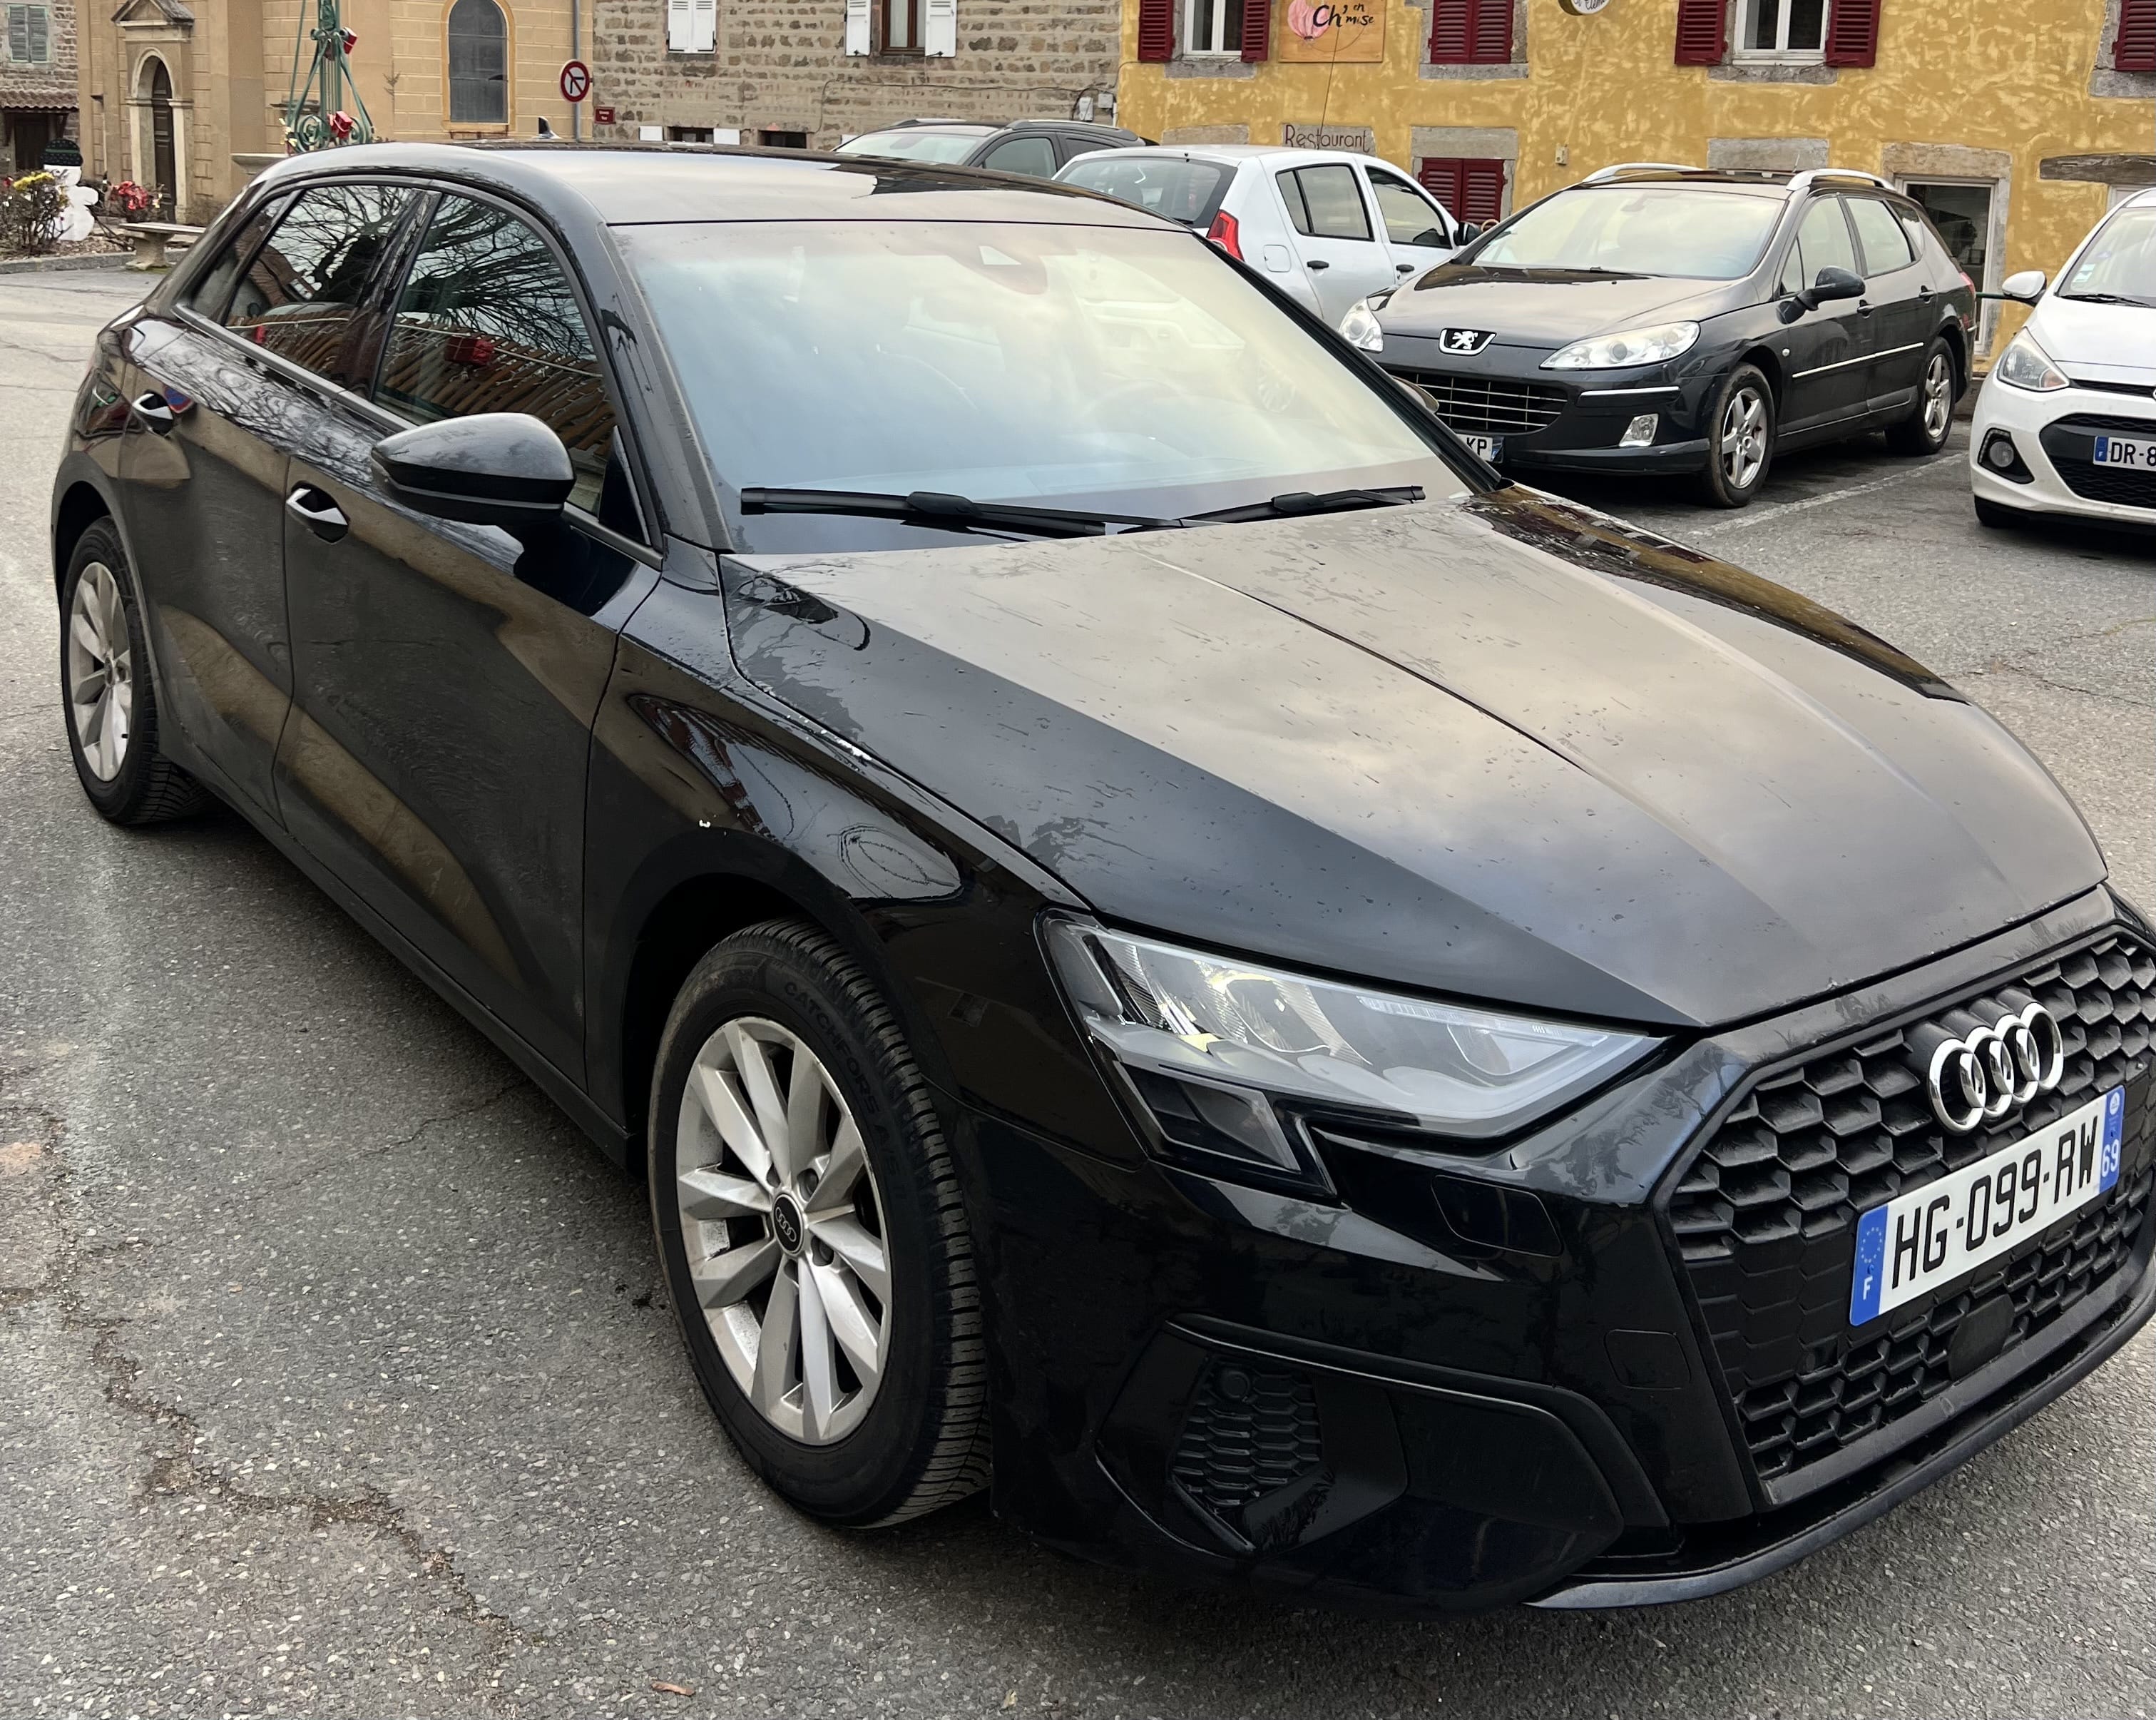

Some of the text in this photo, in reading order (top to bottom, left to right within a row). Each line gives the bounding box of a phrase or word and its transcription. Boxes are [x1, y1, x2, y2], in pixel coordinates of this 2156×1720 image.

[1284, 124, 1370, 153] Restaurant
[2110, 442, 2156, 467] DR-8
[784, 981, 880, 1114] CATCHFORS
[2101, 1138, 2120, 1178] 69
[1891, 1115, 2098, 1290] HG-099-RW
[1862, 1276, 1874, 1301] F
